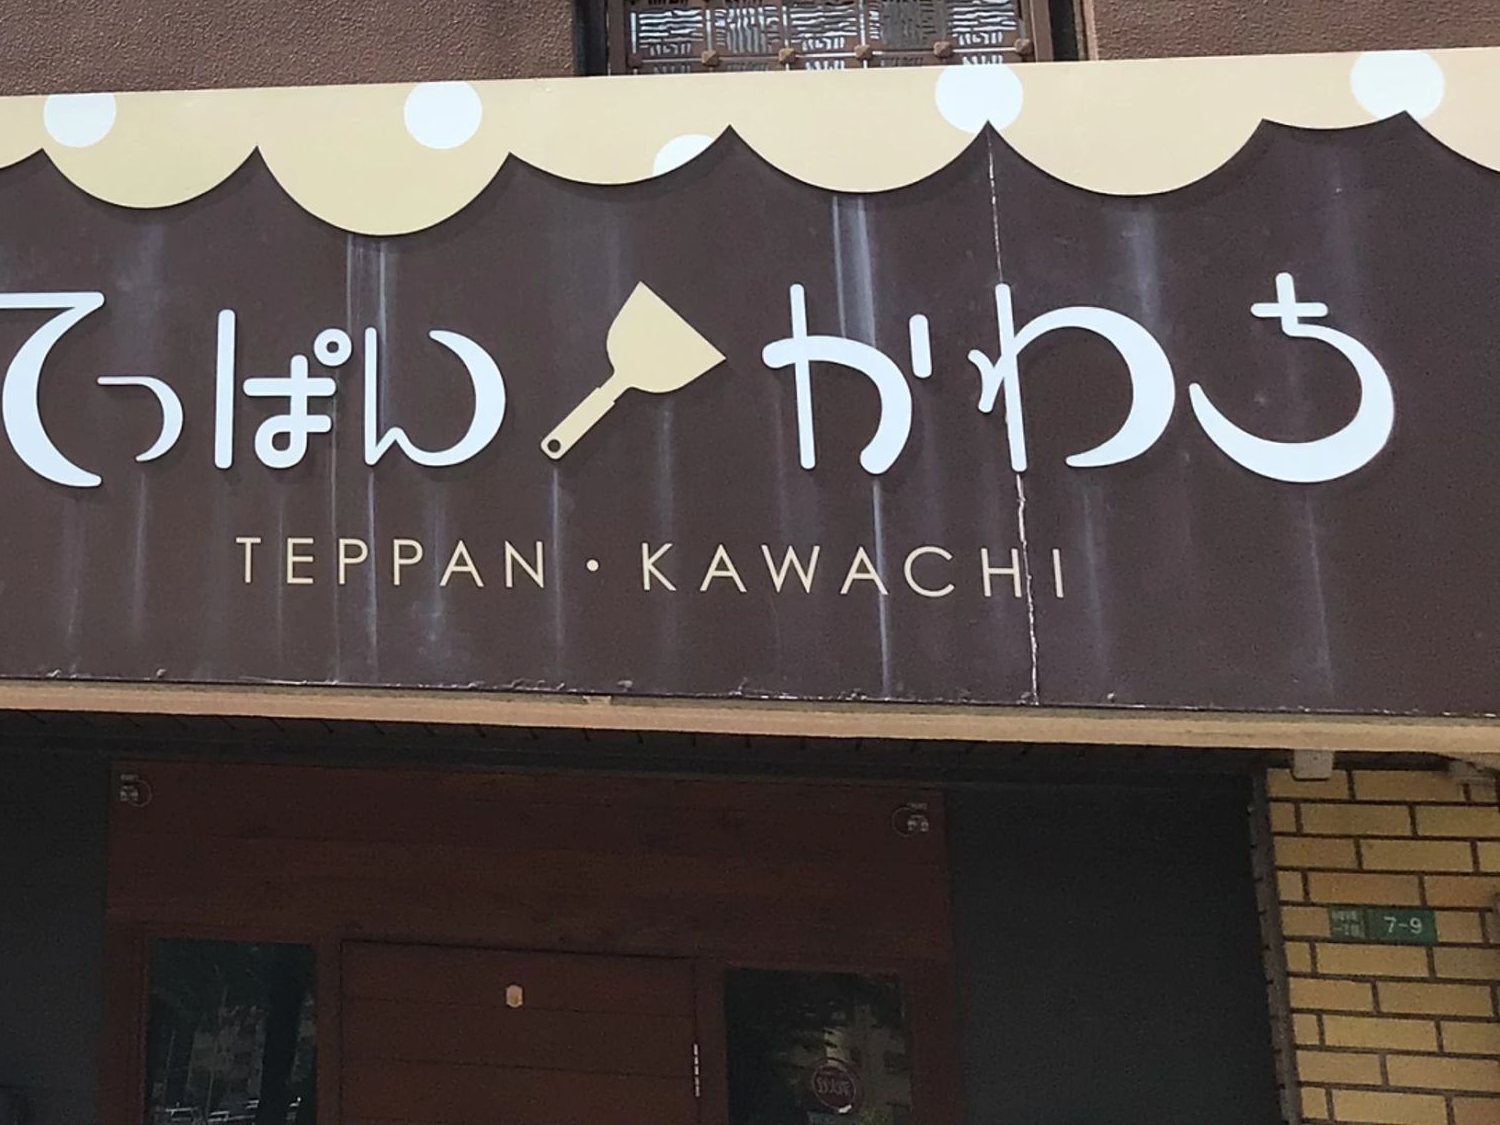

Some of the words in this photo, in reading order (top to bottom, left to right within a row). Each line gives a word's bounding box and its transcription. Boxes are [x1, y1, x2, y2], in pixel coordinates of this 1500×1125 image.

[762, 272, 1395, 483] かわち
[236, 537, 544, 587] TEPPAN
[642, 542, 1064, 598] KAWACHI
[1384, 916, 1422, 934] 7-9
